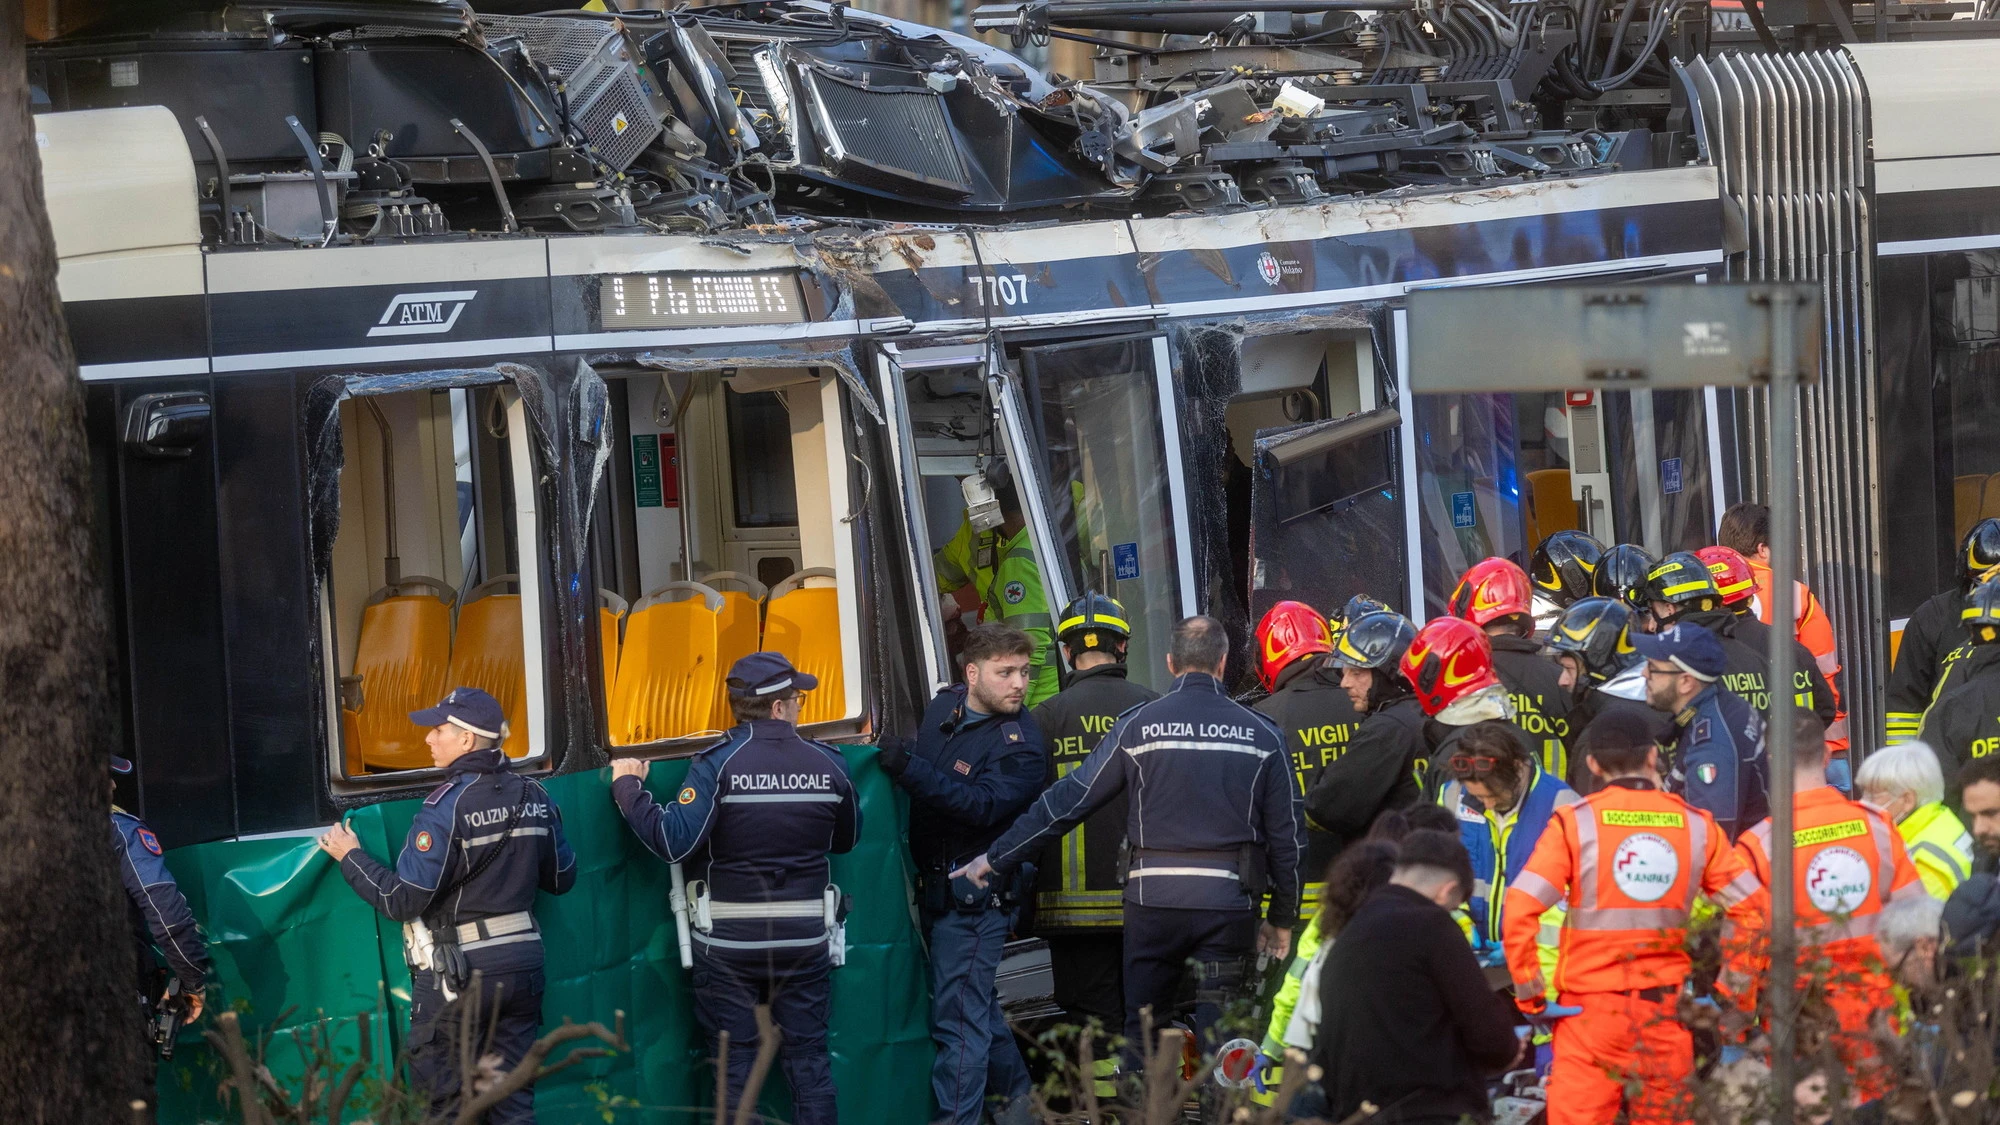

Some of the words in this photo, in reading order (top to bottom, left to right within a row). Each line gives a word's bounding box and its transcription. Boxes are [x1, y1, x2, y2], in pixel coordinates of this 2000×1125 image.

[968, 274, 1029, 306] 7707
[400, 302, 444, 324] ATM
[1722, 672, 1765, 692] VIGILI
[1142, 723, 1194, 739] POLIZIA
[1200, 724, 1255, 741] LOCALE
[731, 774, 779, 790] POLIZIA
[782, 774, 830, 790] LOCALE
[464, 806, 509, 828] POLIZIA
